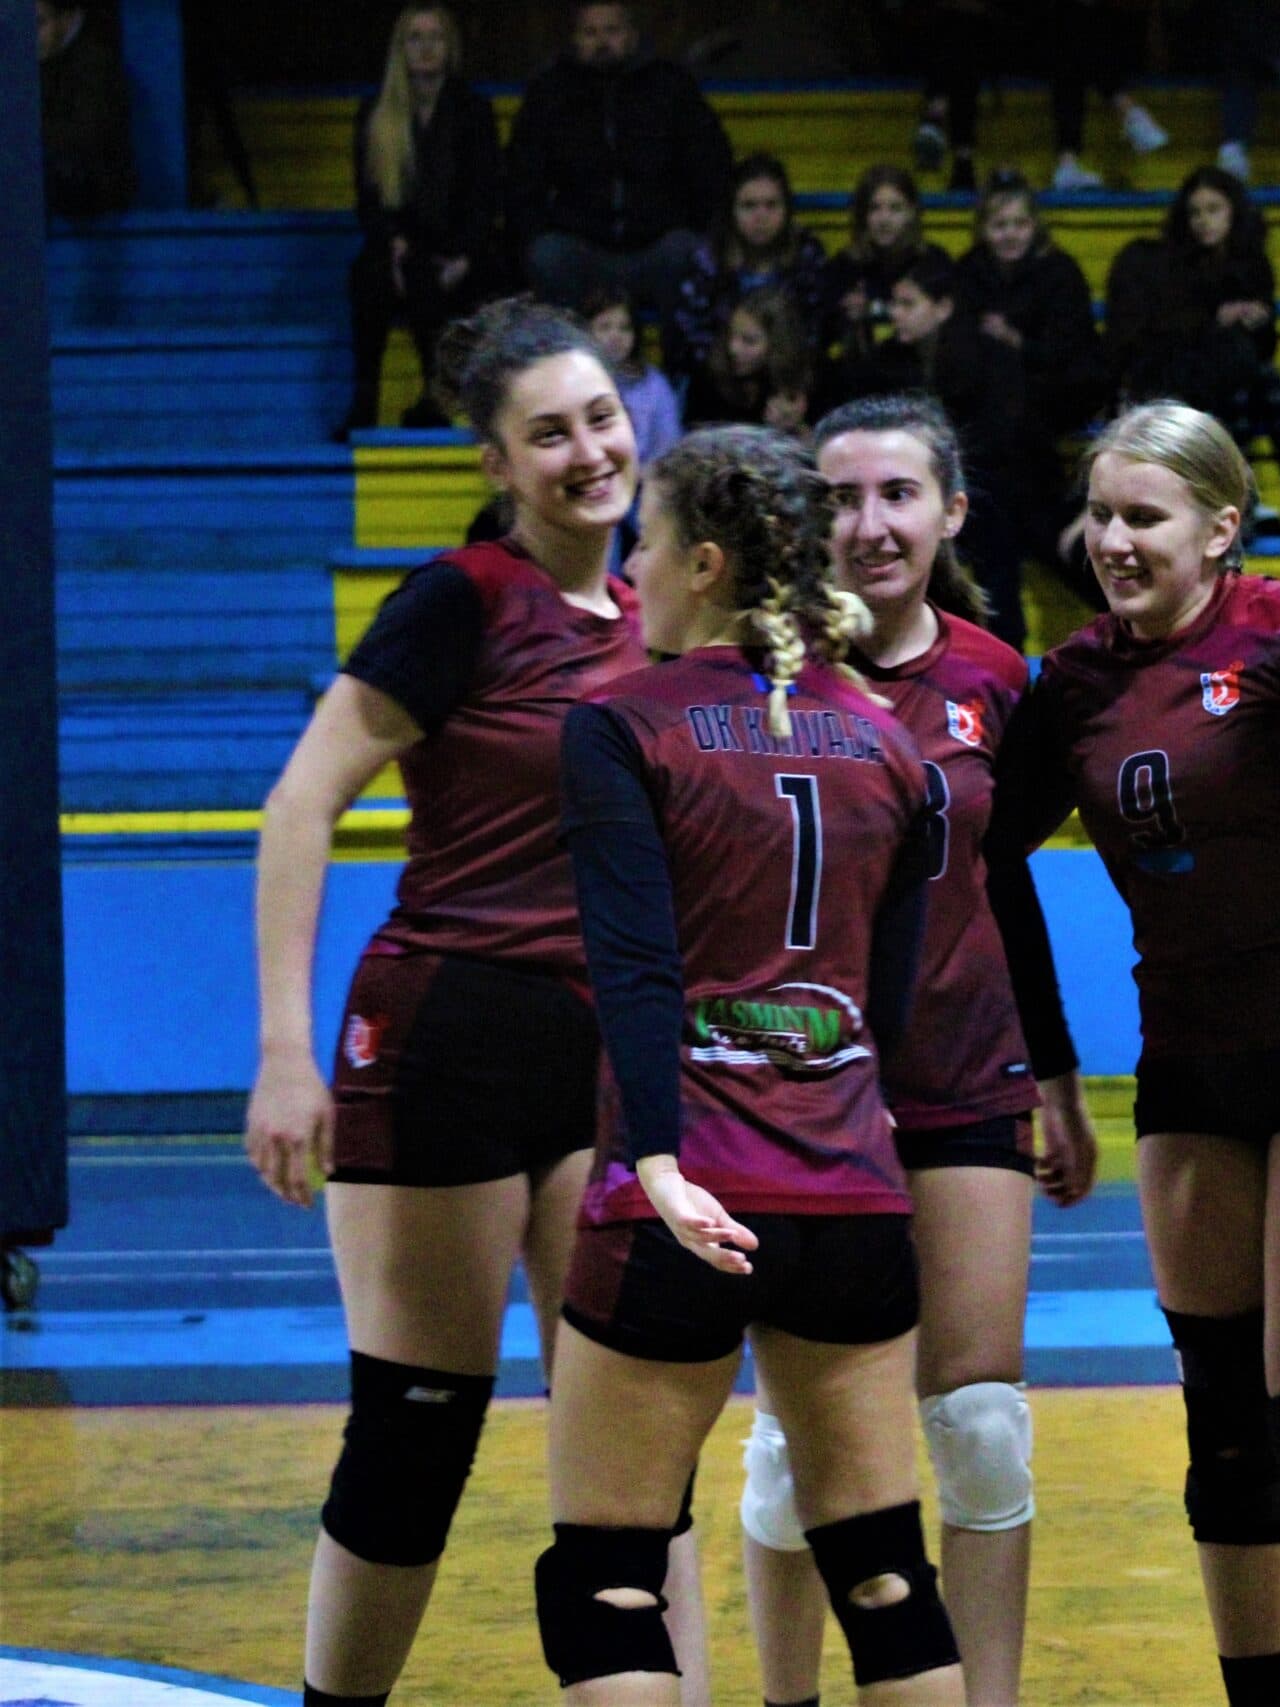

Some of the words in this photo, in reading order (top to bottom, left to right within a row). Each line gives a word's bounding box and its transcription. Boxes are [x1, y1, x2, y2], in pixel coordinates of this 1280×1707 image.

[687, 704, 744, 753] OK
[1117, 749, 1186, 848] 9
[774, 773, 822, 950] 1
